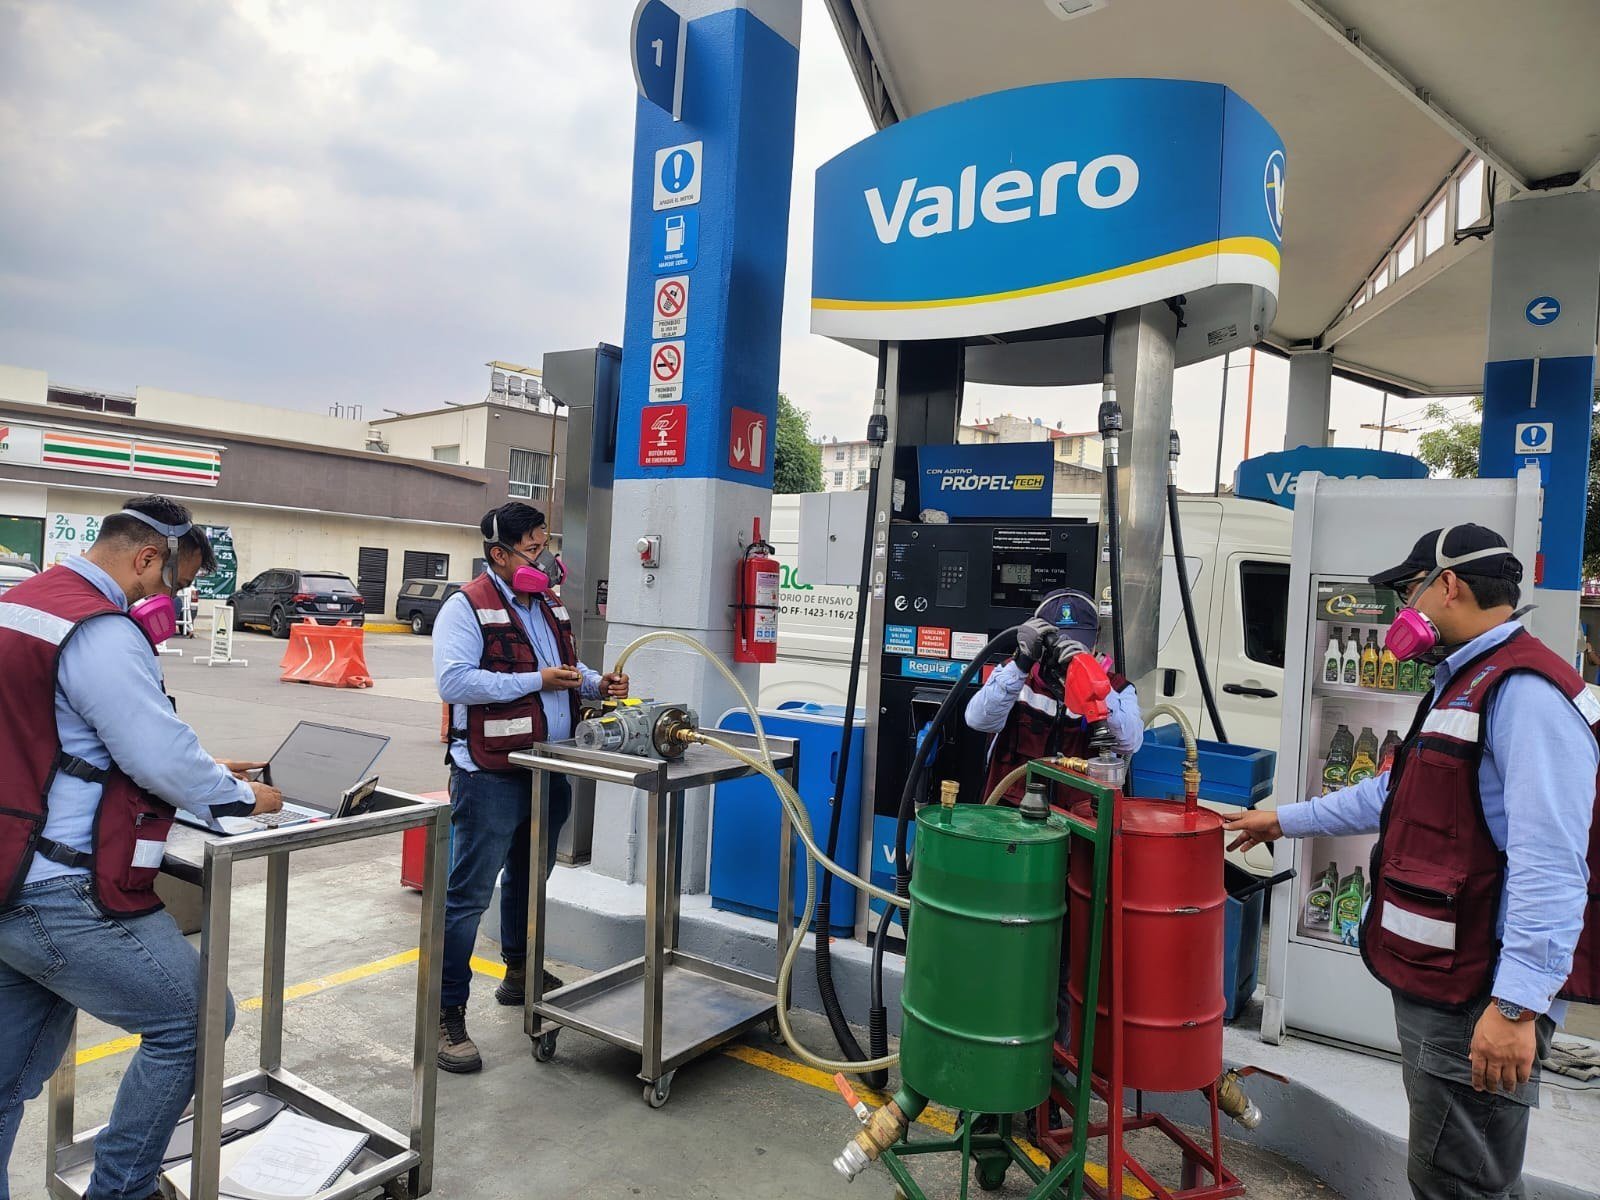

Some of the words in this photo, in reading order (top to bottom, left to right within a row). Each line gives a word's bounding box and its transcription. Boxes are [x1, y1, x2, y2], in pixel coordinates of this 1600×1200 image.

[651, 38, 663, 67] 1
[864, 154, 1140, 244] Valero
[943, 467, 973, 475] ADITIVO
[56, 514, 70, 526] 2x
[86, 516, 100, 528] 2x
[48, 526, 76, 541] $70
[804, 594, 815, 603] DE
[817, 595, 853, 606] ENSAYO
[909, 660, 951, 674] Regular
